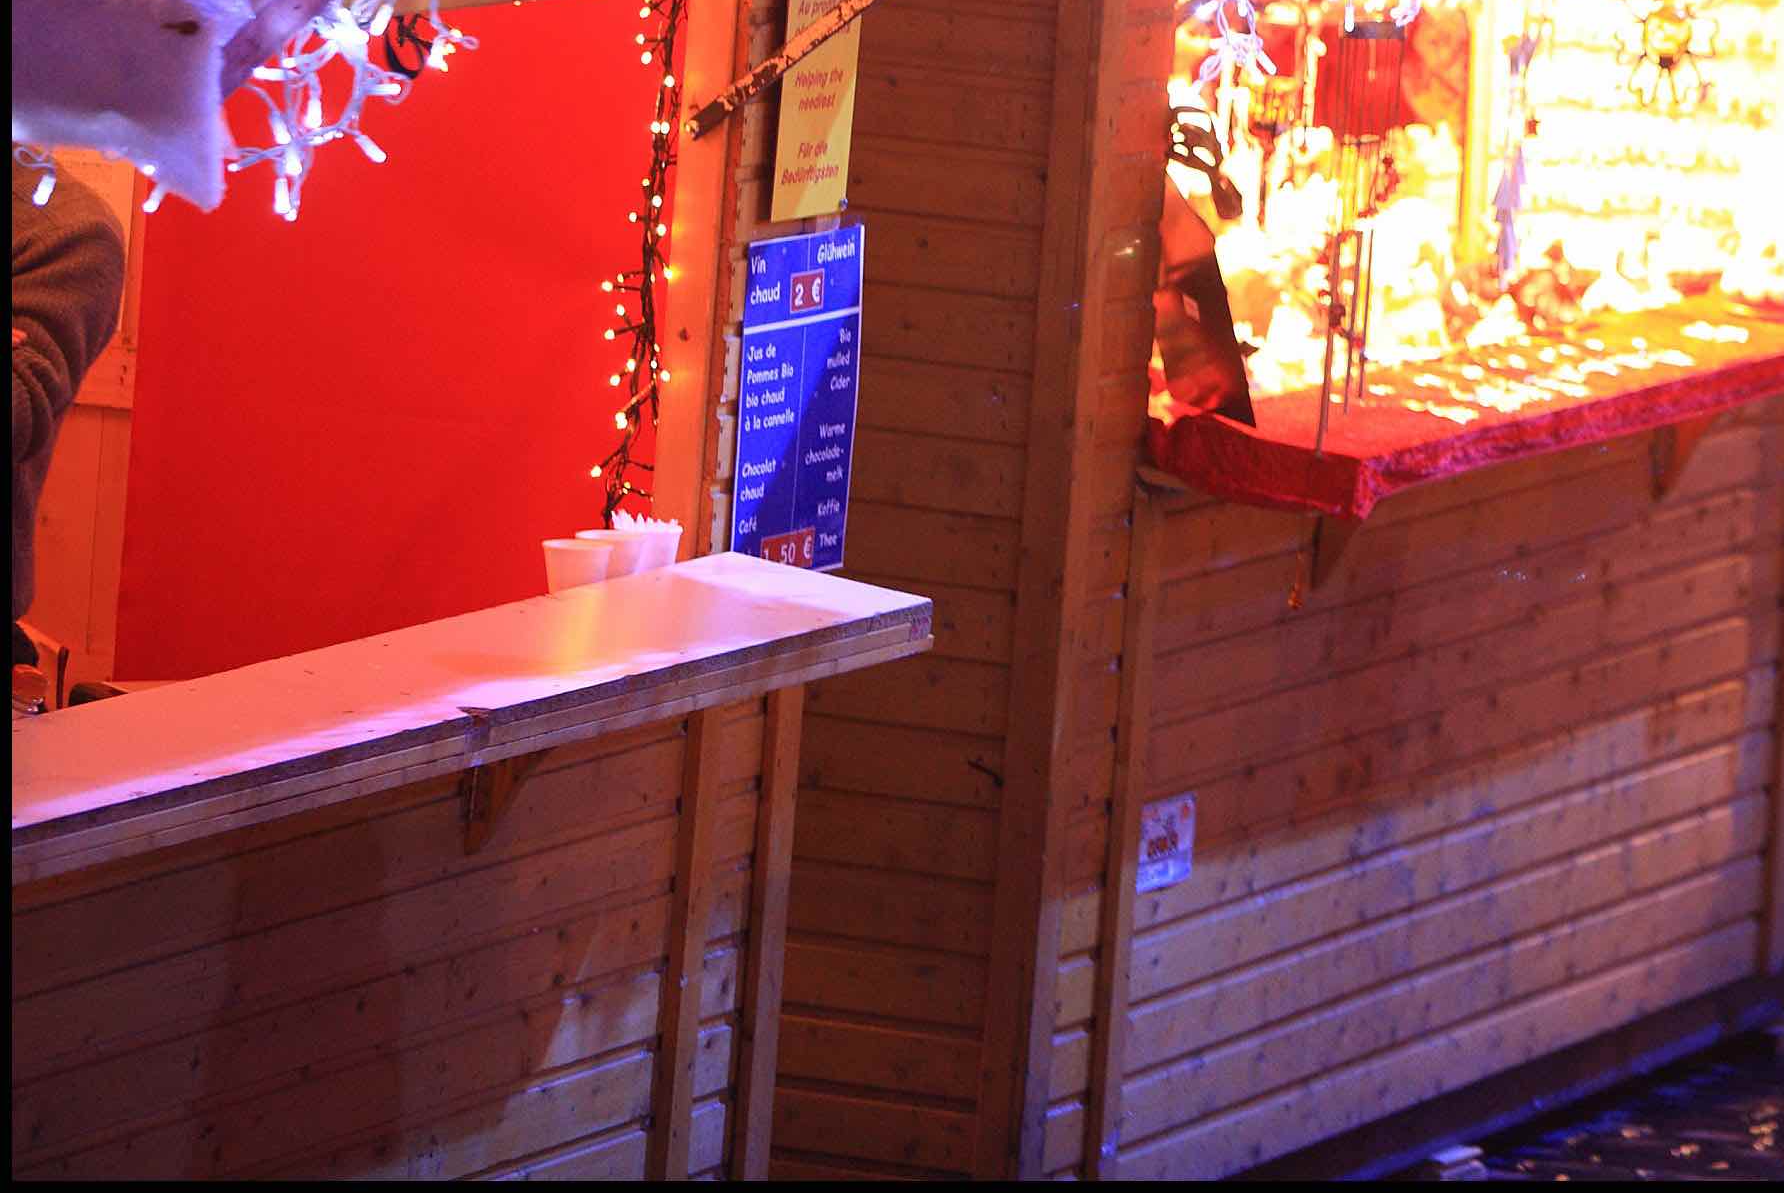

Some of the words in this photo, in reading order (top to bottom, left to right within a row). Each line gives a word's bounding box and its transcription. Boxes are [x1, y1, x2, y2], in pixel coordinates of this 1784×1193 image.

[794, 70, 827, 89] Helping
[817, 239, 855, 263] Glühwein
[751, 256, 766, 274] Vin
[750, 281, 780, 304] chaud
[794, 282, 804, 306] 2
[839, 328, 851, 343] Bio
[746, 345, 763, 362] Jus
[765, 343, 777, 358] de
[827, 350, 850, 368] mulled
[746, 367, 778, 384] Pommes
[781, 362, 793, 378] Bio
[830, 374, 850, 390] Cider
[745, 392, 759, 408] bio
[761, 386, 785, 405] chaud
[753, 414, 761, 430] la
[763, 406, 794, 428] cannelle
[819, 422, 845, 438] Warme
[741, 458, 776, 478] Chocolat
[740, 482, 764, 502] chaud
[817, 498, 839, 516] Koffie
[738, 515, 757, 534] Café
[819, 533, 837, 547] Thee
